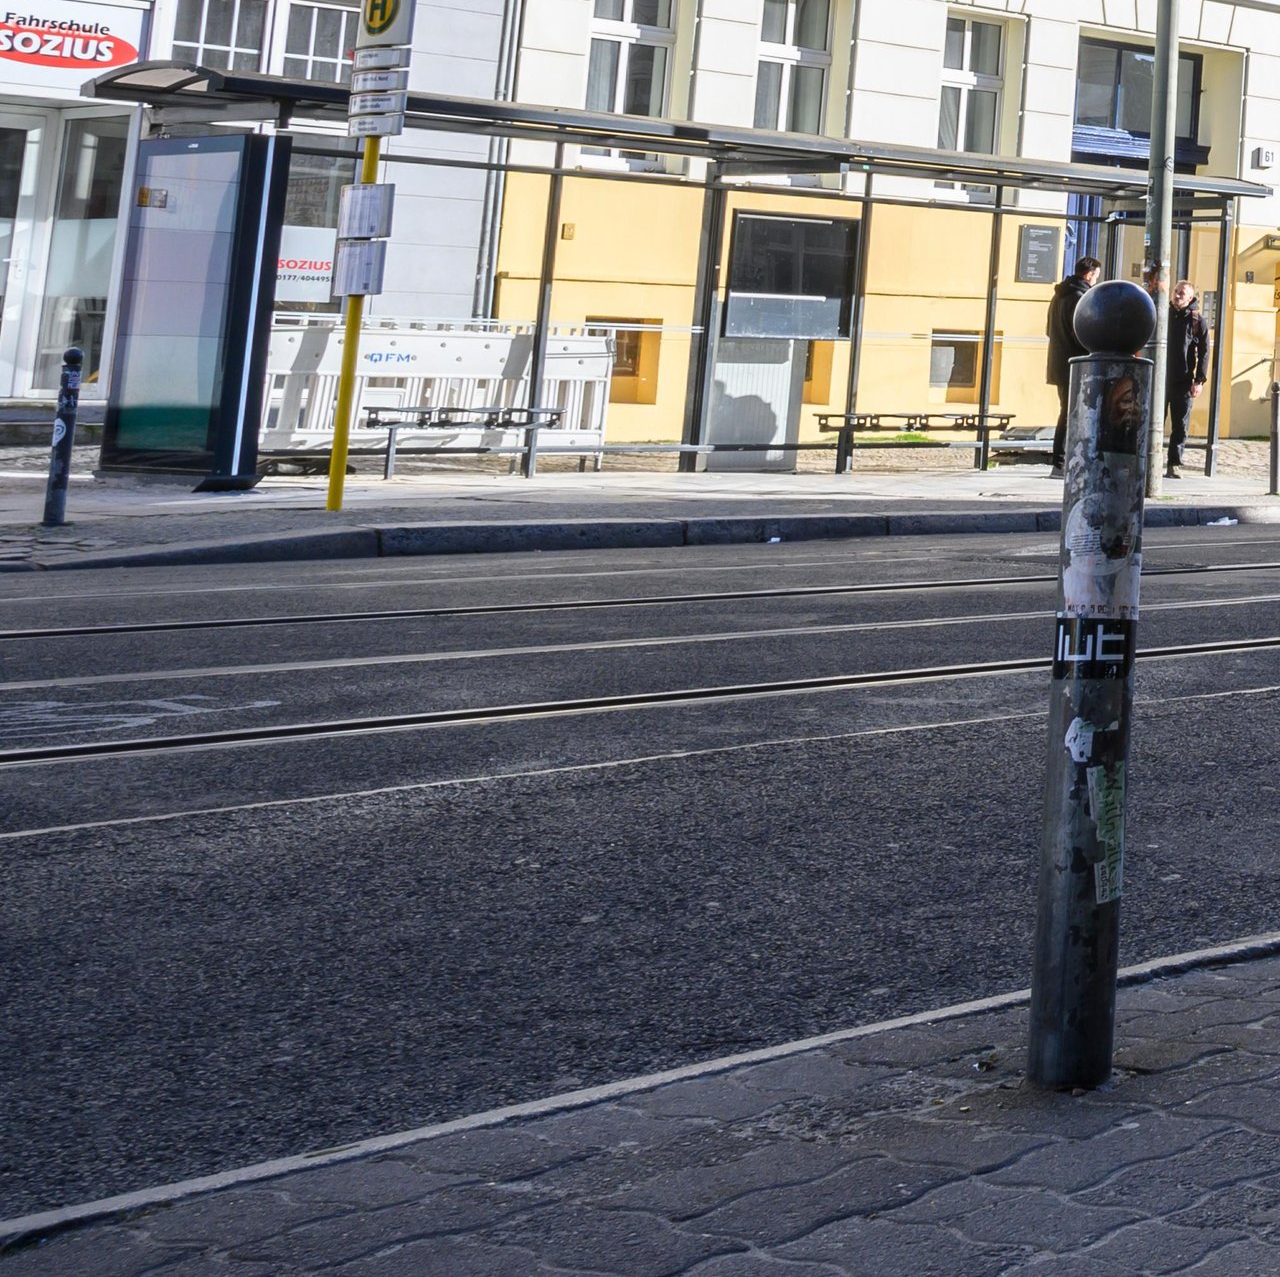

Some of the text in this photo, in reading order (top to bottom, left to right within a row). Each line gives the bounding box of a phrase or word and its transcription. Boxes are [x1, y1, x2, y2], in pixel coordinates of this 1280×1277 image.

[5, 12, 110, 35] Fahrschule
[0, 29, 114, 62] SOZIUS
[1265, 151, 1274, 162] 61
[277, 260, 332, 271] SOZIUS
